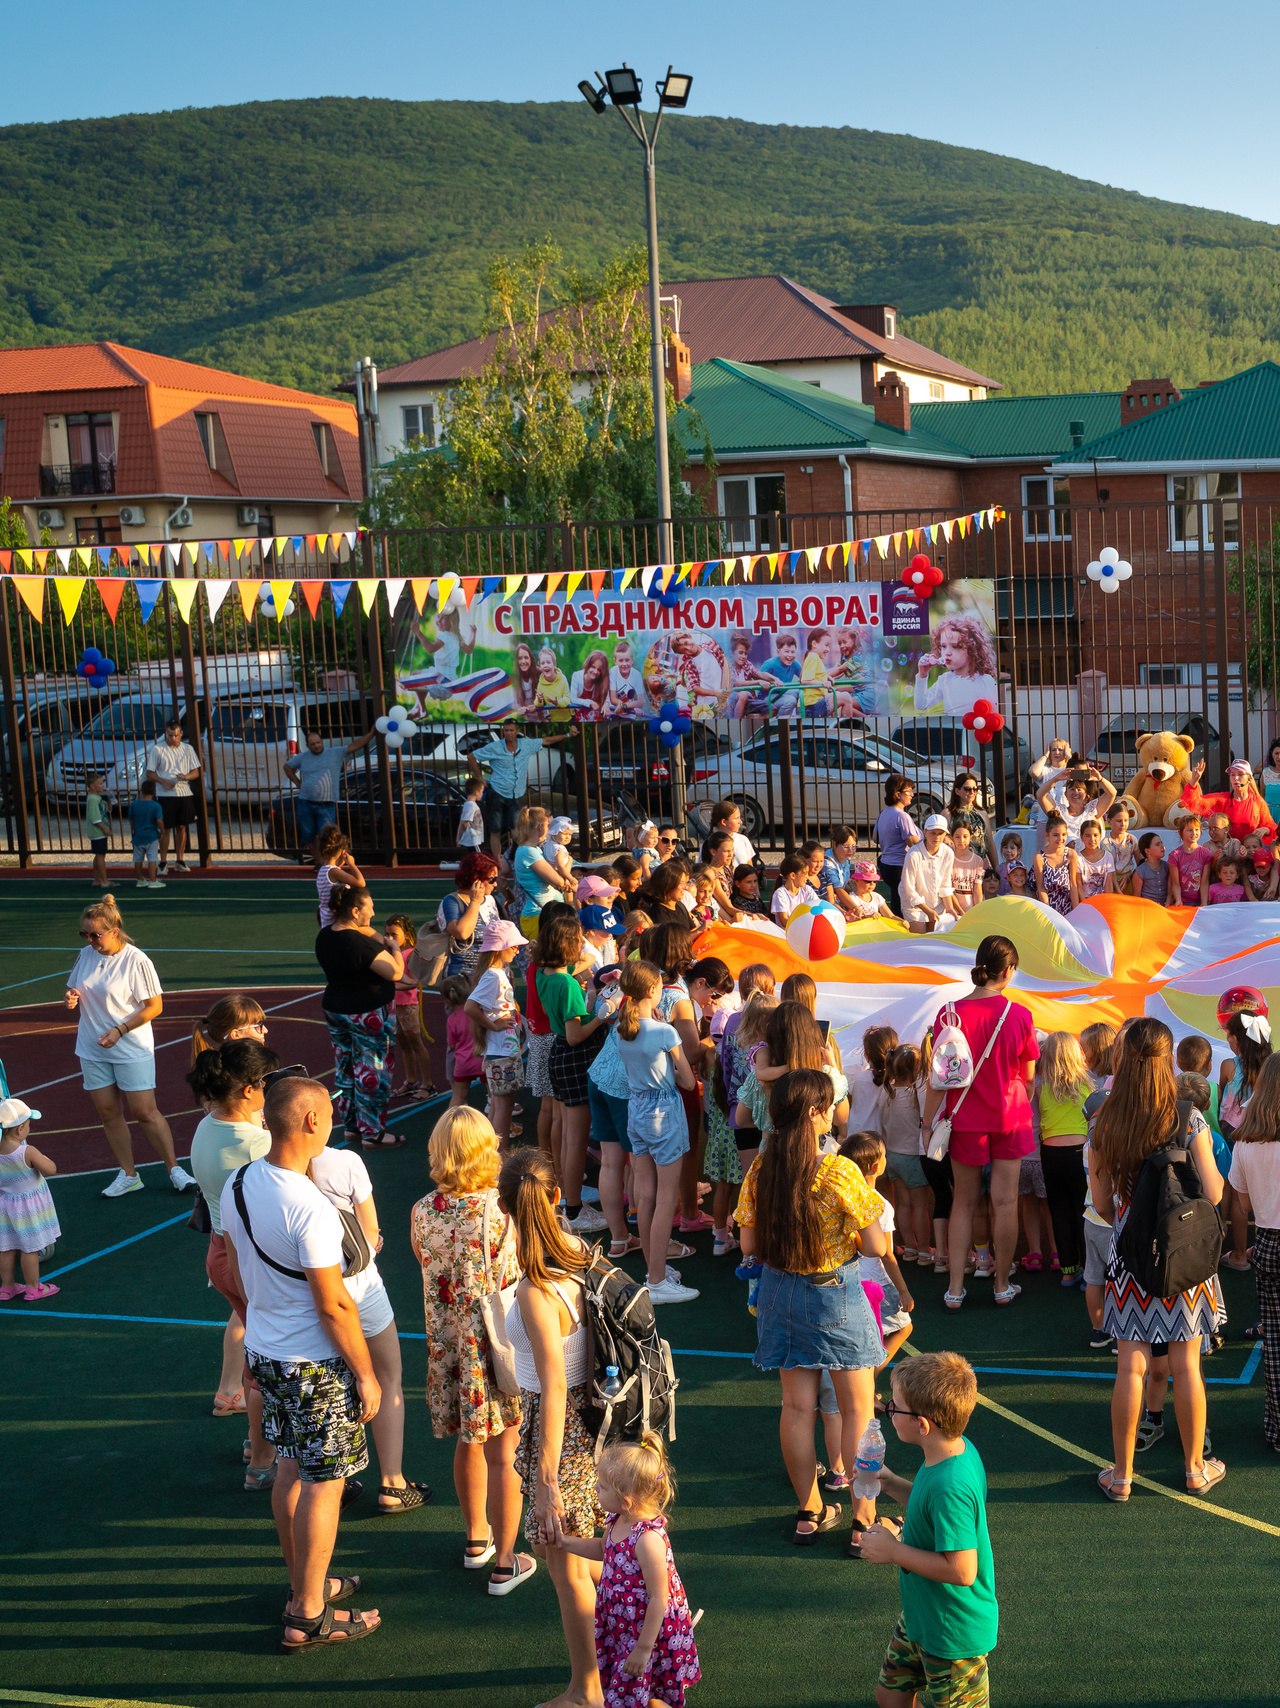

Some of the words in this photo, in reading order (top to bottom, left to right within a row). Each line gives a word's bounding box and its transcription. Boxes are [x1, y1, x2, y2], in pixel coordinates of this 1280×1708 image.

[495, 602, 513, 634] С
[522, 599, 744, 638] ПРАЗДНИКОМ
[752, 594, 880, 635] ДВОРА!
